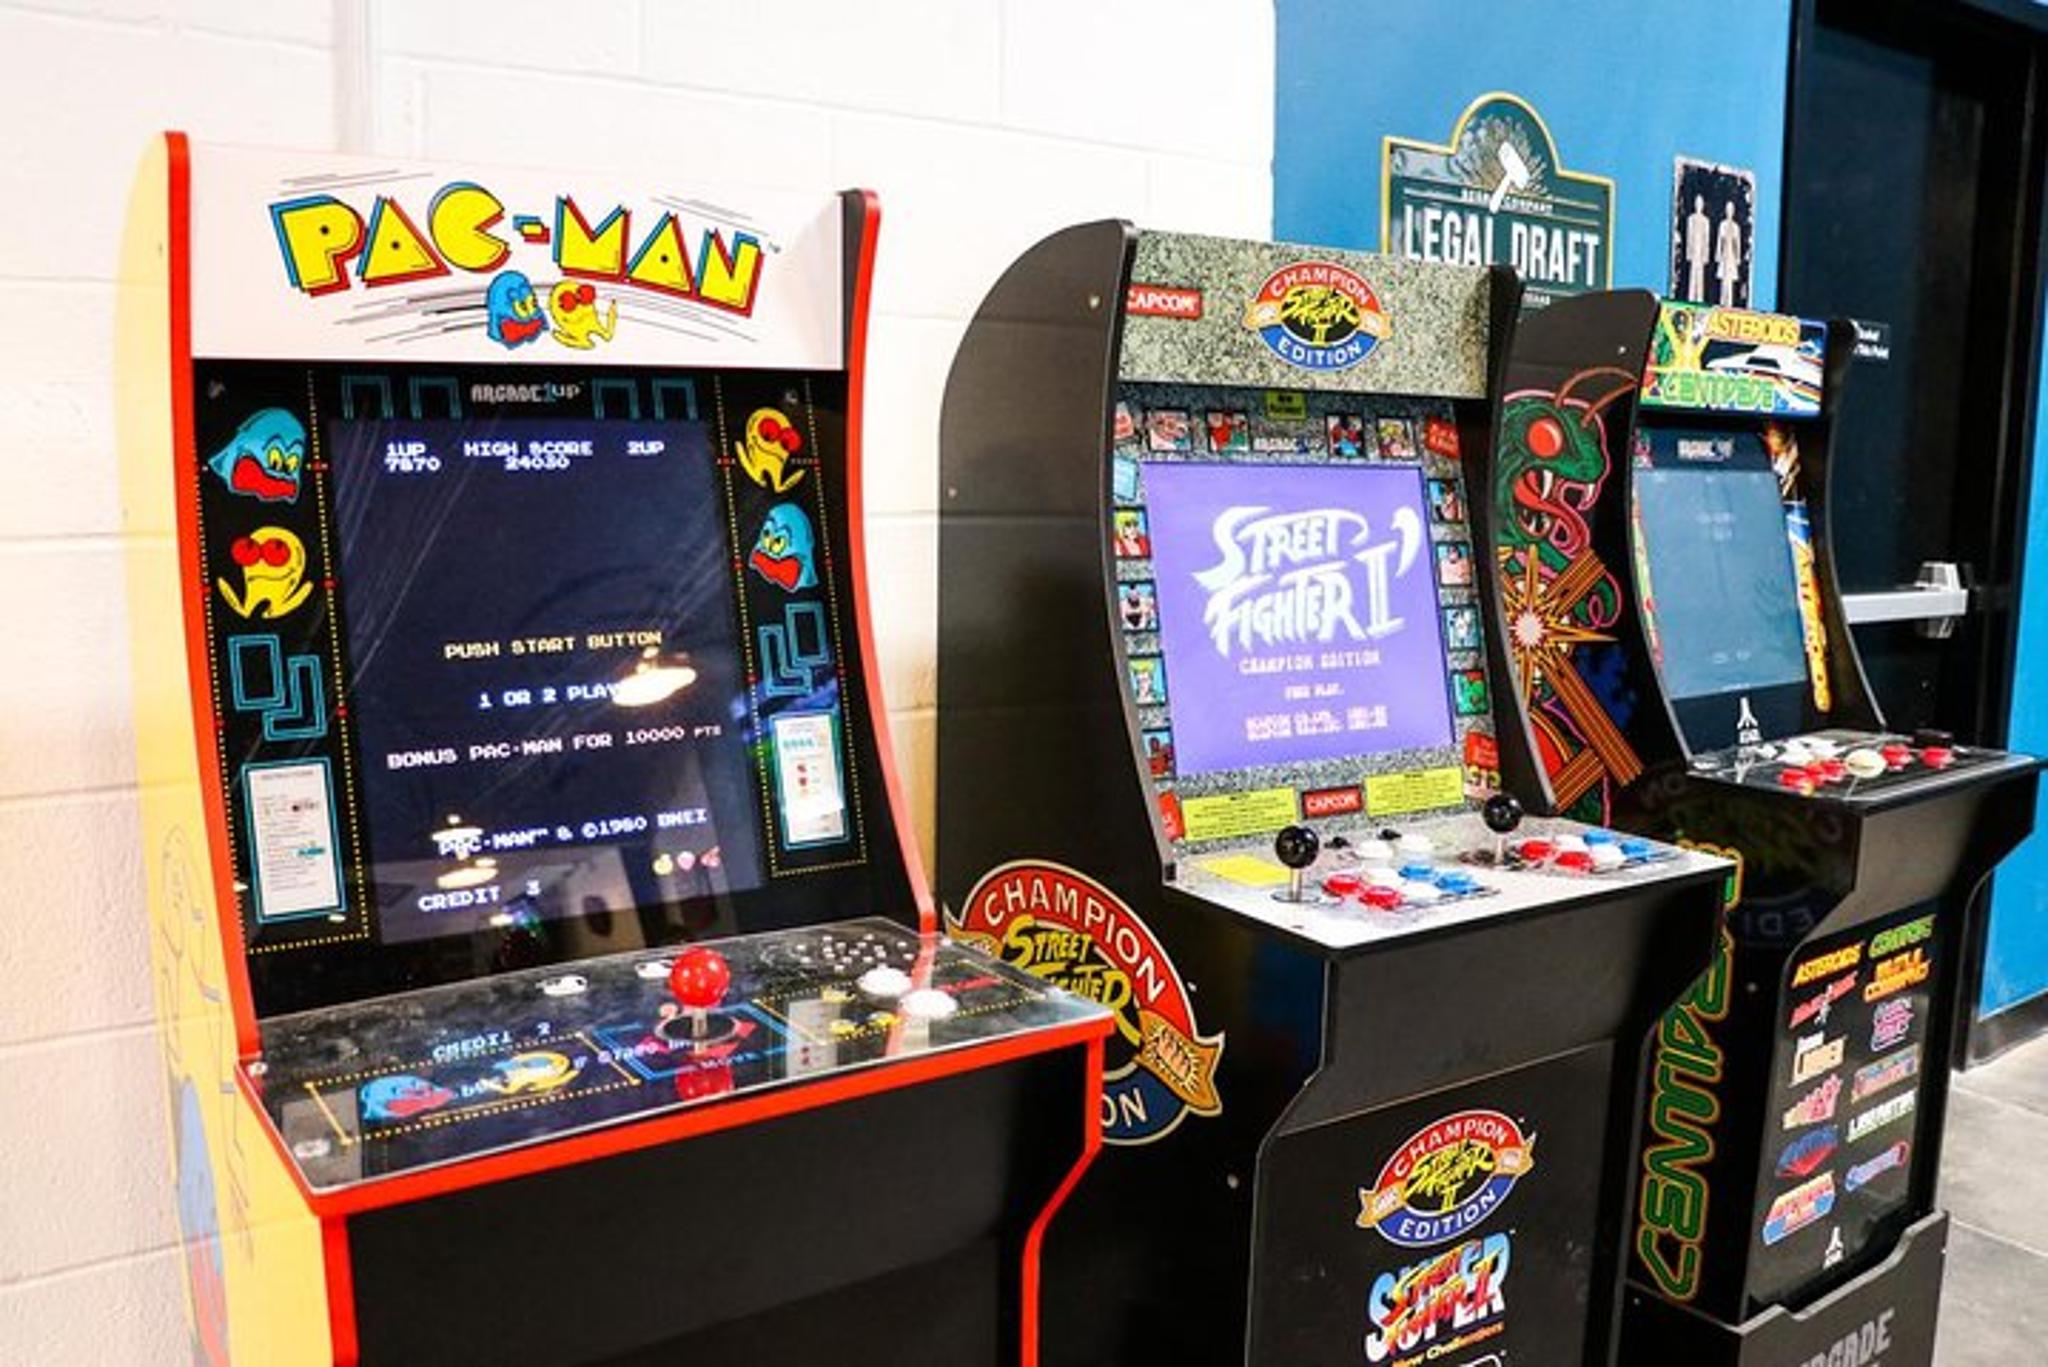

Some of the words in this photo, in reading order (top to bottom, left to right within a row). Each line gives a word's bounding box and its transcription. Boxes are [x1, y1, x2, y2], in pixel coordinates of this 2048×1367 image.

[269, 181, 764, 318] PAC-MAN
[1403, 204, 1498, 267] LEGAL
[1511, 221, 1600, 286] DRAFT
[1270, 266, 1371, 305] CHAMPION
[1278, 336, 1362, 366] EDITION
[1707, 309, 1800, 345] ASTEROIDS
[384, 456, 441, 472] 7870
[504, 455, 571, 471] 24030
[385, 441, 426, 457] 1UP
[462, 442, 518, 457] HIGH
[528, 440, 594, 457] SCORE
[626, 440, 665, 456] 2UP
[1193, 506, 1370, 590] STREET
[1204, 562, 1367, 659] FIGHTER
[444, 642, 500, 660] PUSH
[511, 636, 575, 655] START
[587, 630, 662, 650] BUTTON
[478, 692, 493, 708] 1
[503, 689, 532, 707] OR
[542, 688, 557, 703] 2
[567, 681, 617, 700] PLAY
[386, 748, 458, 770] BONUS
[573, 732, 613, 751] FOR
[625, 725, 685, 746] 10000
[417, 886, 501, 912] CREDIT
[525, 879, 542, 896] 3
[984, 878, 1166, 1003] CHAMPION
[1002, 914, 1093, 970] STREET
[1393, 1118, 1507, 1177] CHAMPION
[1399, 1187, 1498, 1240] EDITION
[1799, 1307, 1896, 1367] CADE
